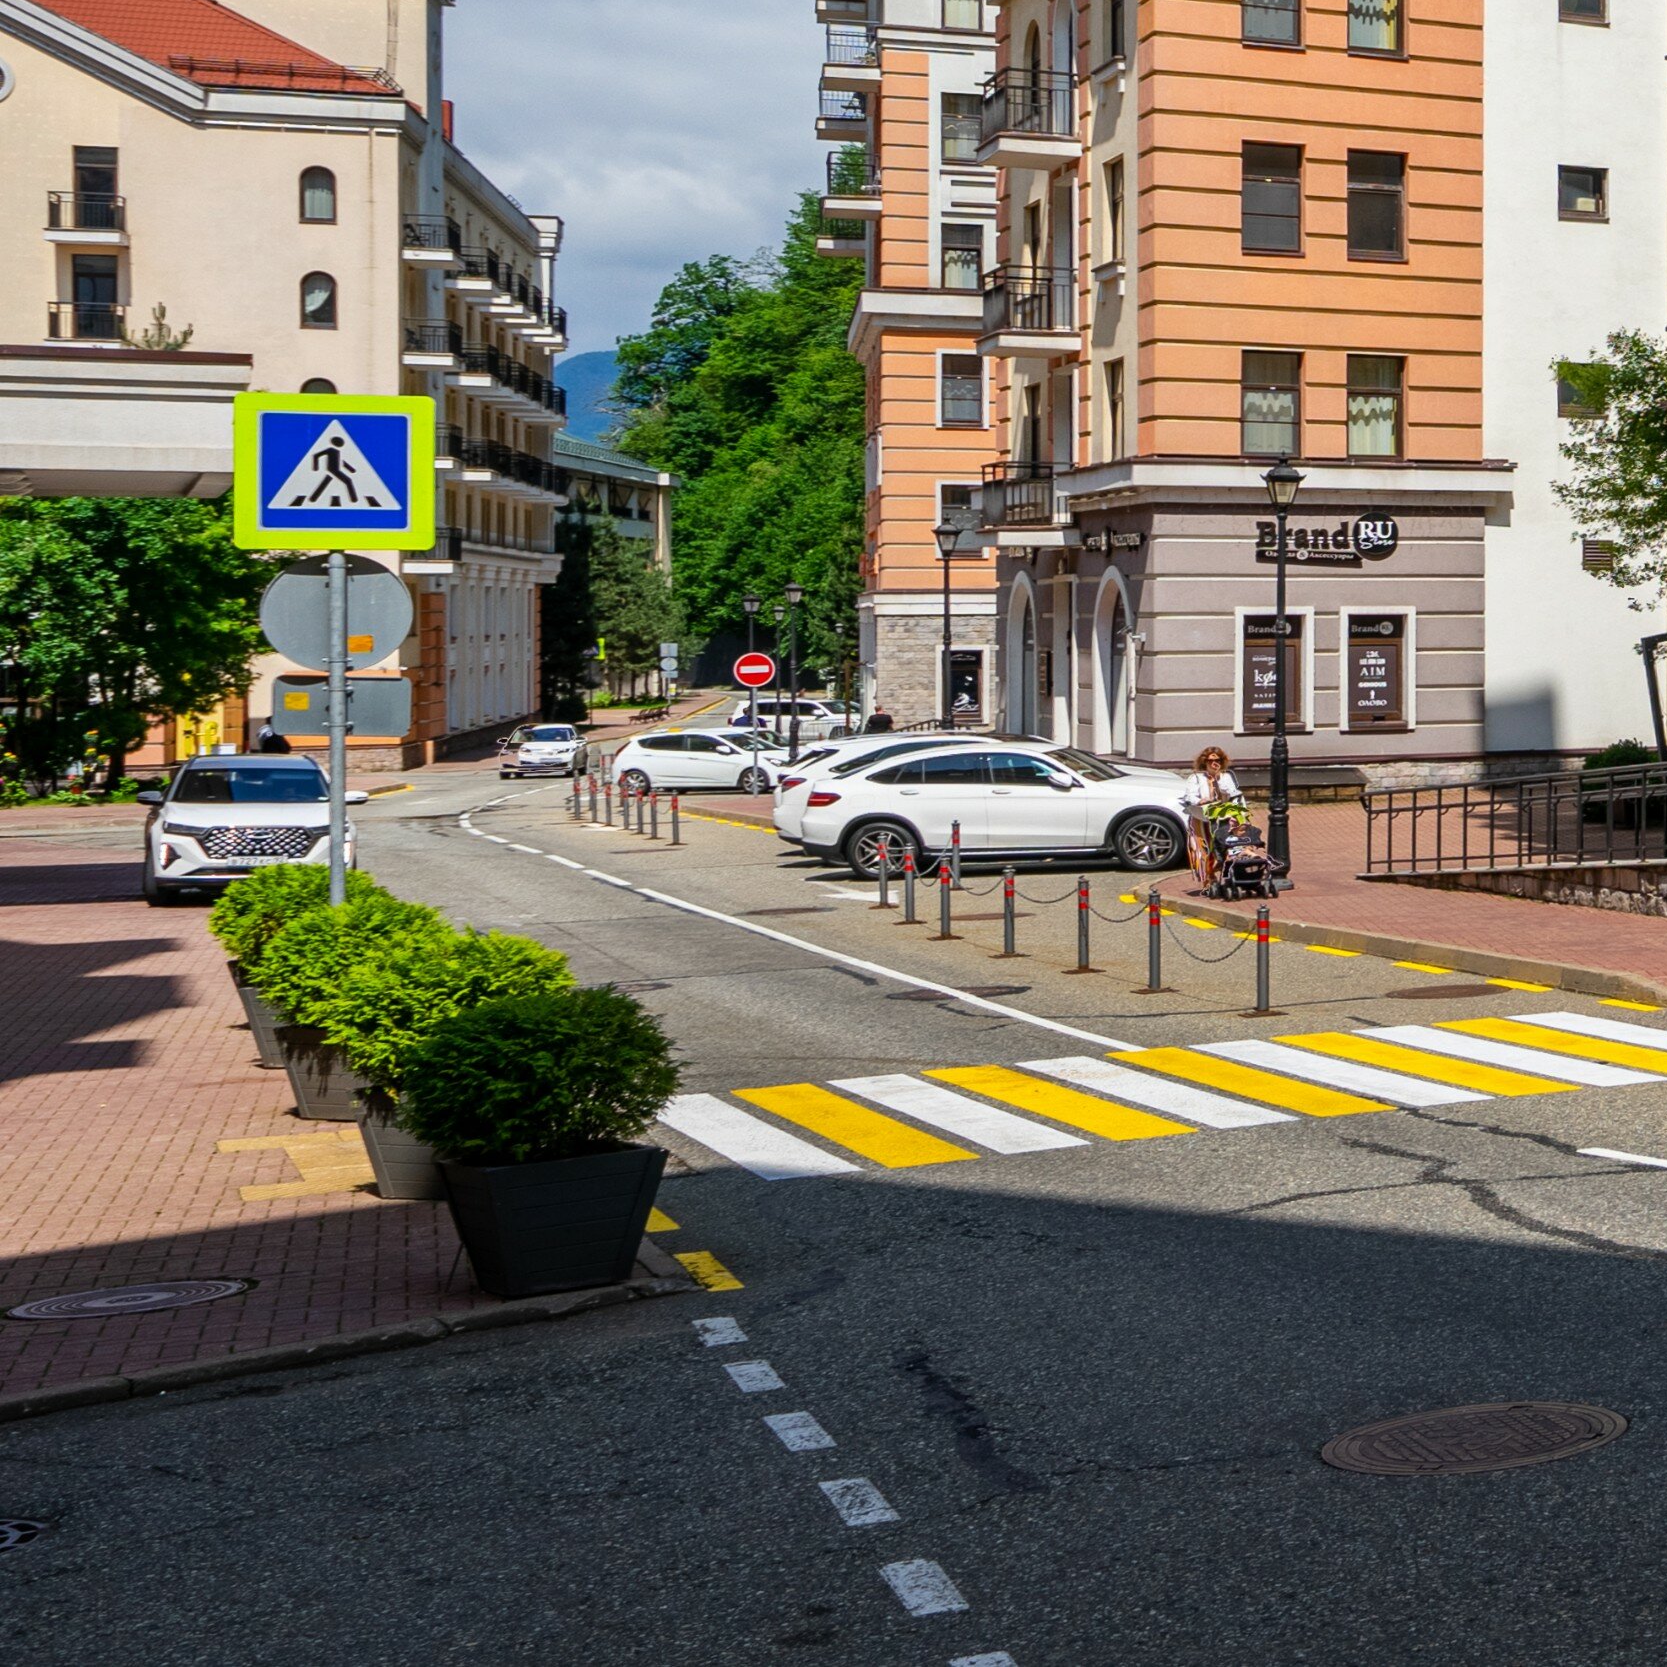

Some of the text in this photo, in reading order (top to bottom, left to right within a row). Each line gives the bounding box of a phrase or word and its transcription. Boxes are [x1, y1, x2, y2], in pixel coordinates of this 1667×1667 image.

[1358, 521, 1394, 539] RU
[1358, 533, 1395, 550] Store
[1351, 624, 1379, 633] Brand
[1360, 666, 1386, 677] AIM
